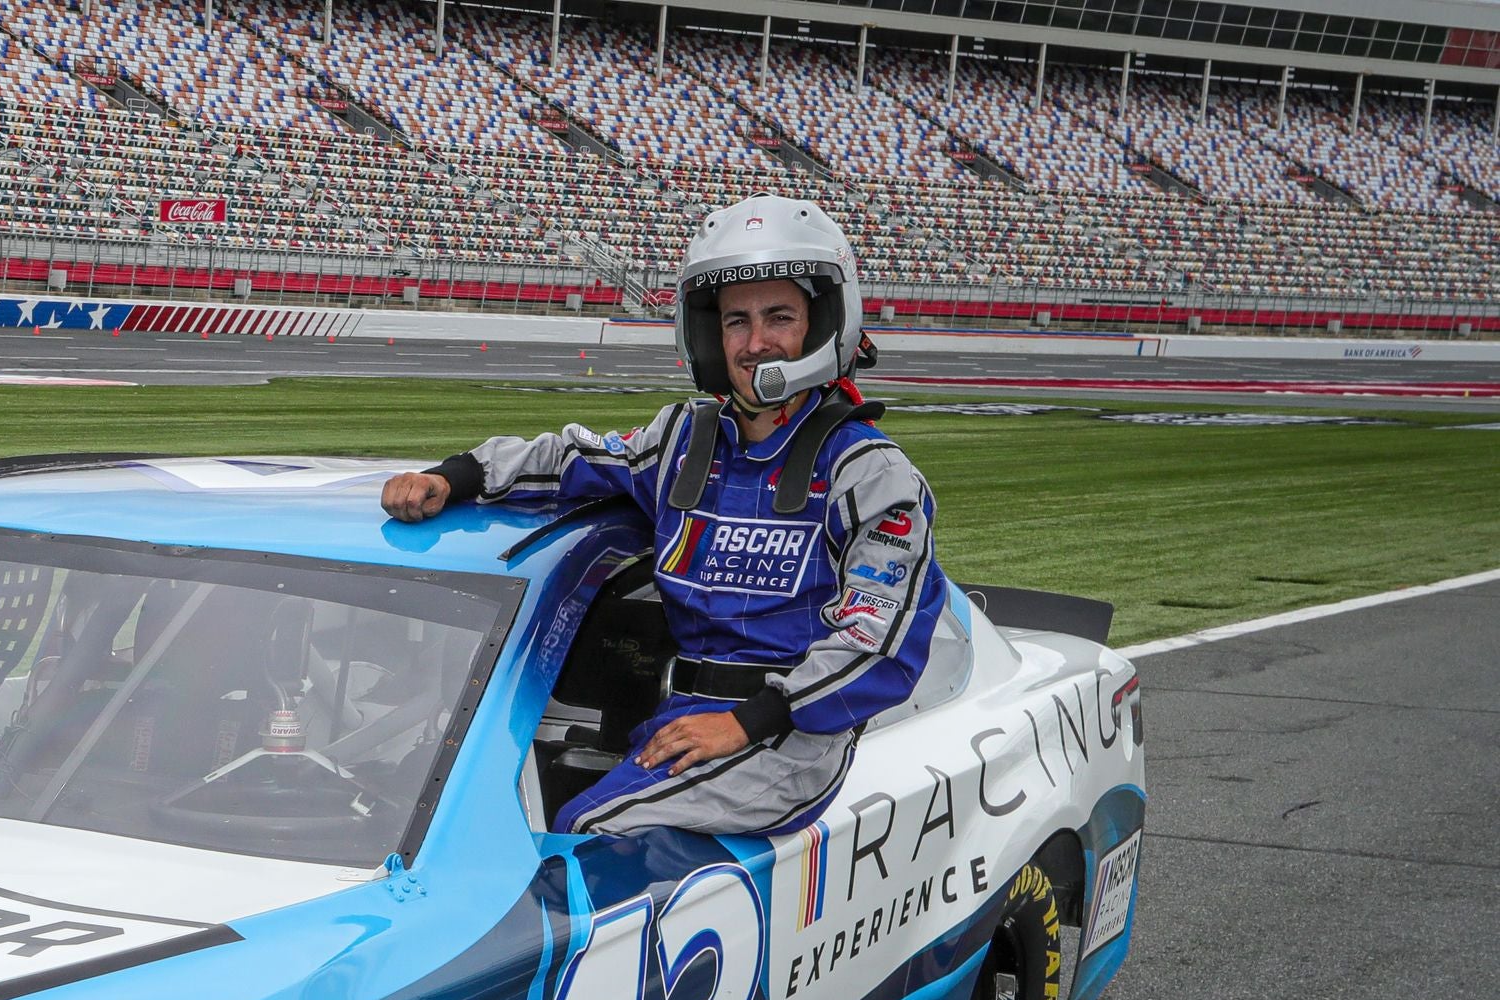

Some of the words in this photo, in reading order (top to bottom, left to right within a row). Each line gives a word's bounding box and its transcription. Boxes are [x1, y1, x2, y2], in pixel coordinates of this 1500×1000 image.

[696, 261, 818, 287] PYROTECT
[1344, 348, 1363, 357] BANK
[1365, 349, 1374, 357] OF
[1374, 349, 1406, 358] AMERICA
[710, 525, 805, 556] ASCAR
[700, 570, 790, 588] PERIENCE
[847, 669, 1117, 901] RACING
[1105, 839, 1138, 896] NASCAR
[785, 855, 988, 999] EXPERIENCE
